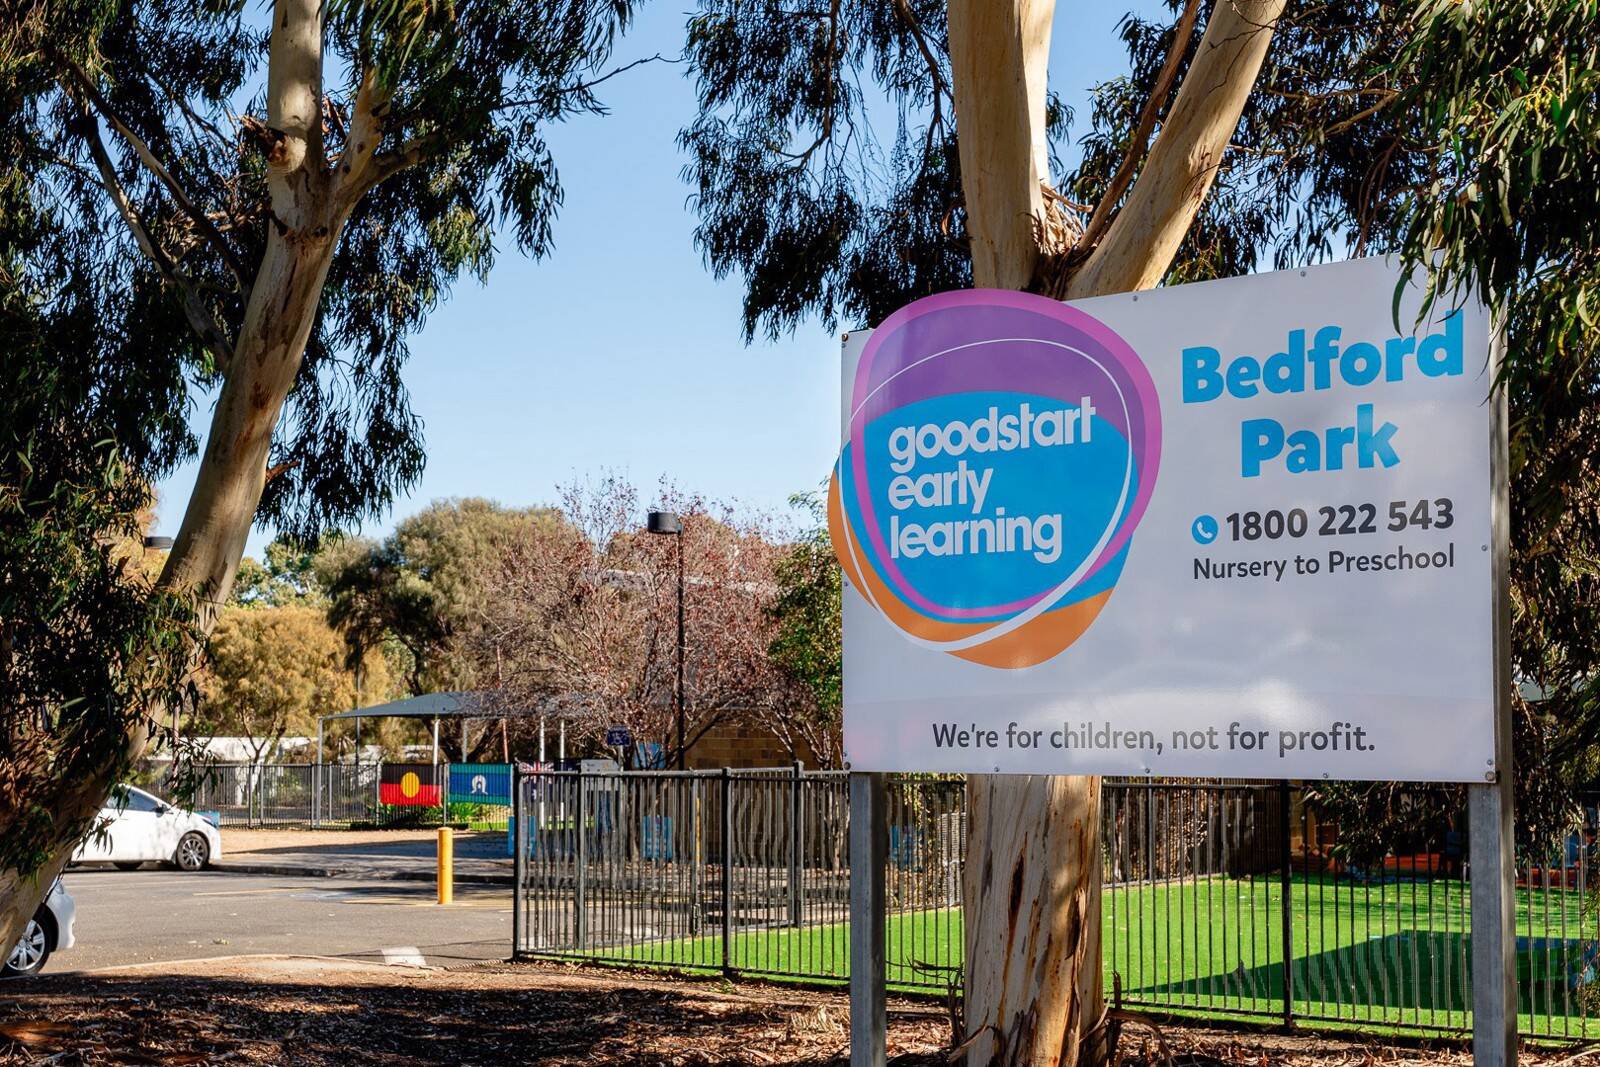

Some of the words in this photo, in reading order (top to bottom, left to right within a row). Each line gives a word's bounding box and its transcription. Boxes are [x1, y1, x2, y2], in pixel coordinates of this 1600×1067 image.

[1181, 307, 1465, 404] Bedford
[888, 396, 1097, 474] goodstart
[1240, 403, 1401, 479] Park
[888, 460, 994, 514] early
[890, 506, 1063, 564] learning
[1225, 507, 1309, 541] 1800
[1317, 502, 1377, 536] 222
[1386, 497, 1454, 533] 543
[1193, 557, 1287, 583] Nursery
[1294, 554, 1321, 576] to
[1328, 541, 1455, 574] Preschool
[932, 722, 999, 749] We're
[1005, 721, 1043, 749] for
[1049, 721, 1163, 756] children,
[1172, 726, 1220, 751] not
[1226, 721, 1270, 751] for
[1278, 721, 1376, 759] profit.
